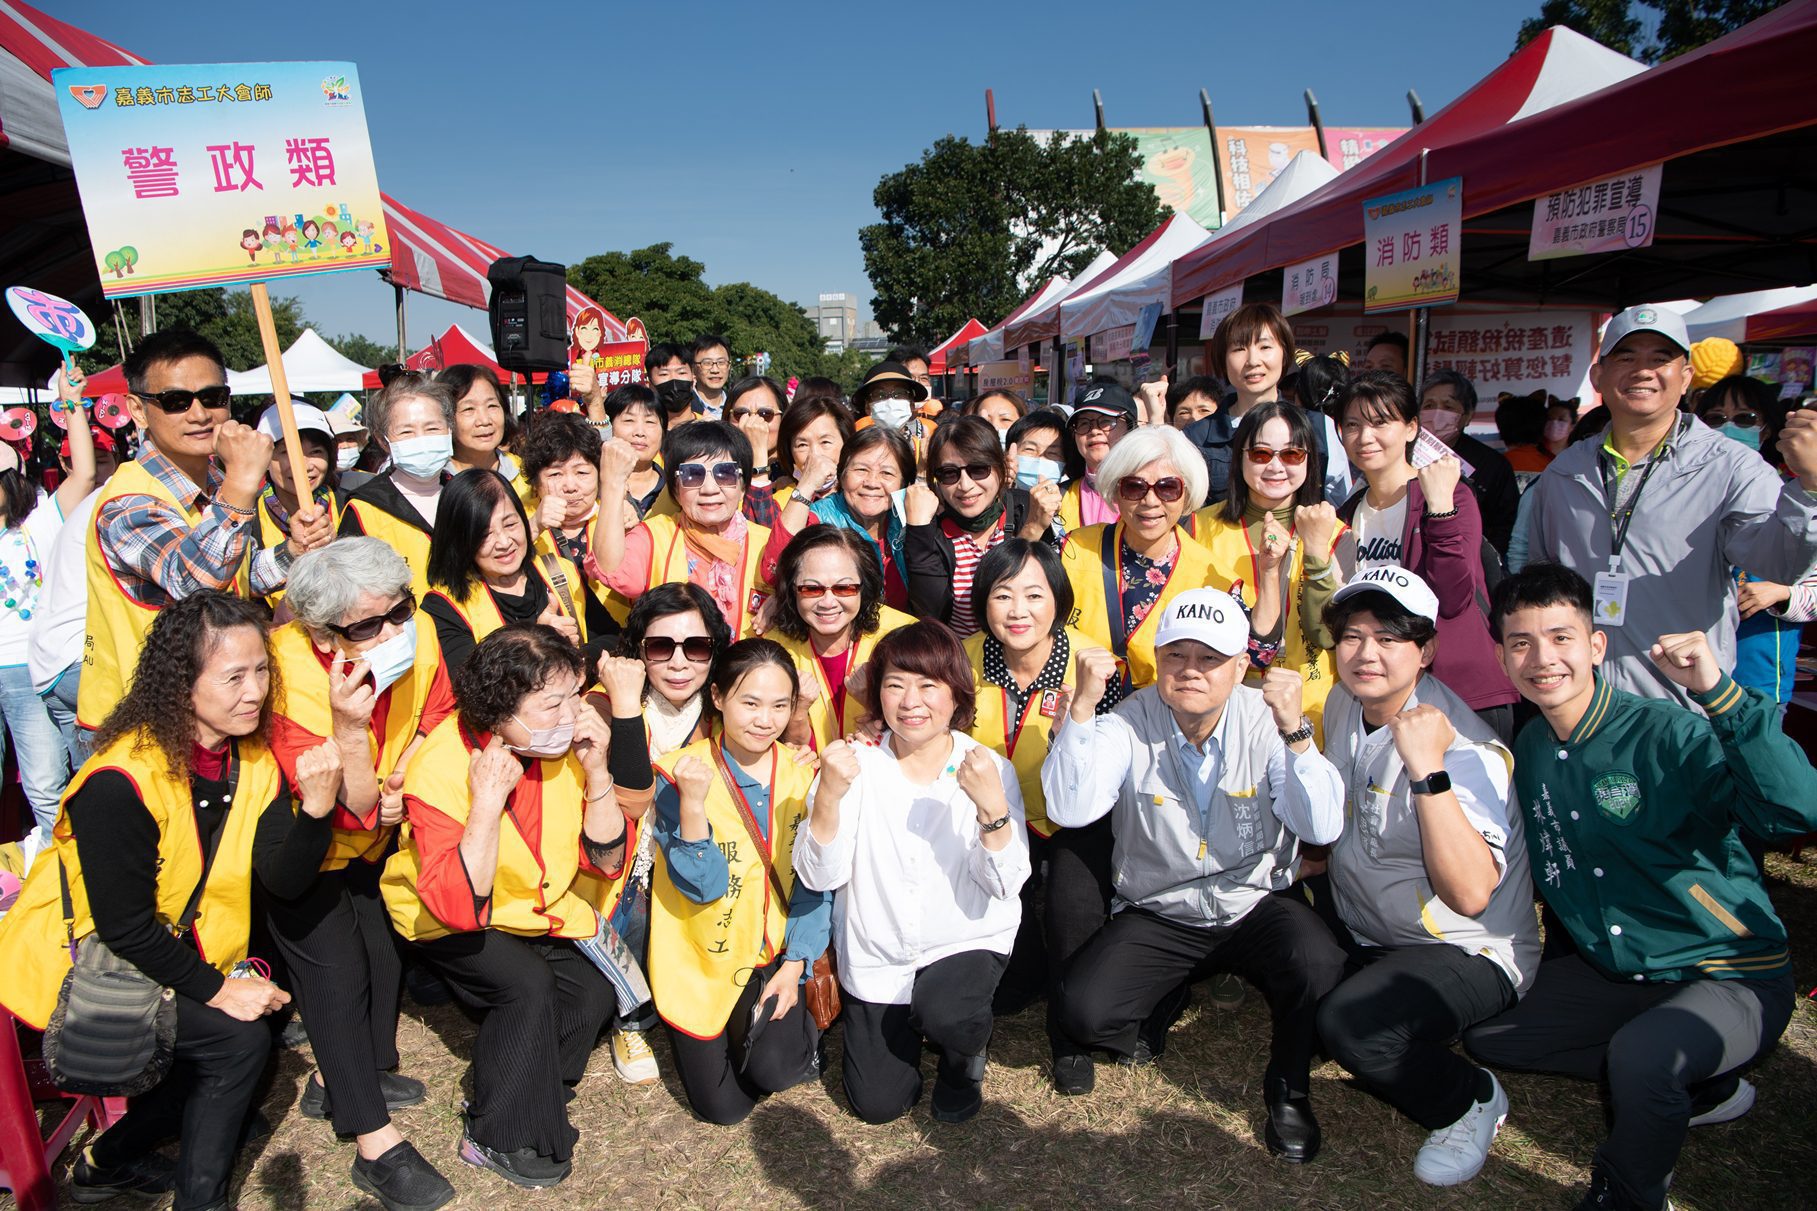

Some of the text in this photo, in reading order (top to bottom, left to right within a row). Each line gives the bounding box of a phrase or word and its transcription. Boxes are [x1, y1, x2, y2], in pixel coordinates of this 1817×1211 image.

[114, 83, 273, 107] 嘉義市志工大會師
[121, 137, 337, 199] 警政類
[1546, 174, 1644, 222] 預防犯罪宣導
[1552, 216, 1627, 244] 嘉義市政府警察局
[1628, 213, 1648, 240] 15
[1376, 223, 1449, 267] 消防類
[598, 369, 642, 387] 宣導分隊
[1361, 569, 1409, 588] KANO
[1176, 603, 1225, 624] KANO
[1234, 803, 1254, 858] 沈炳信
